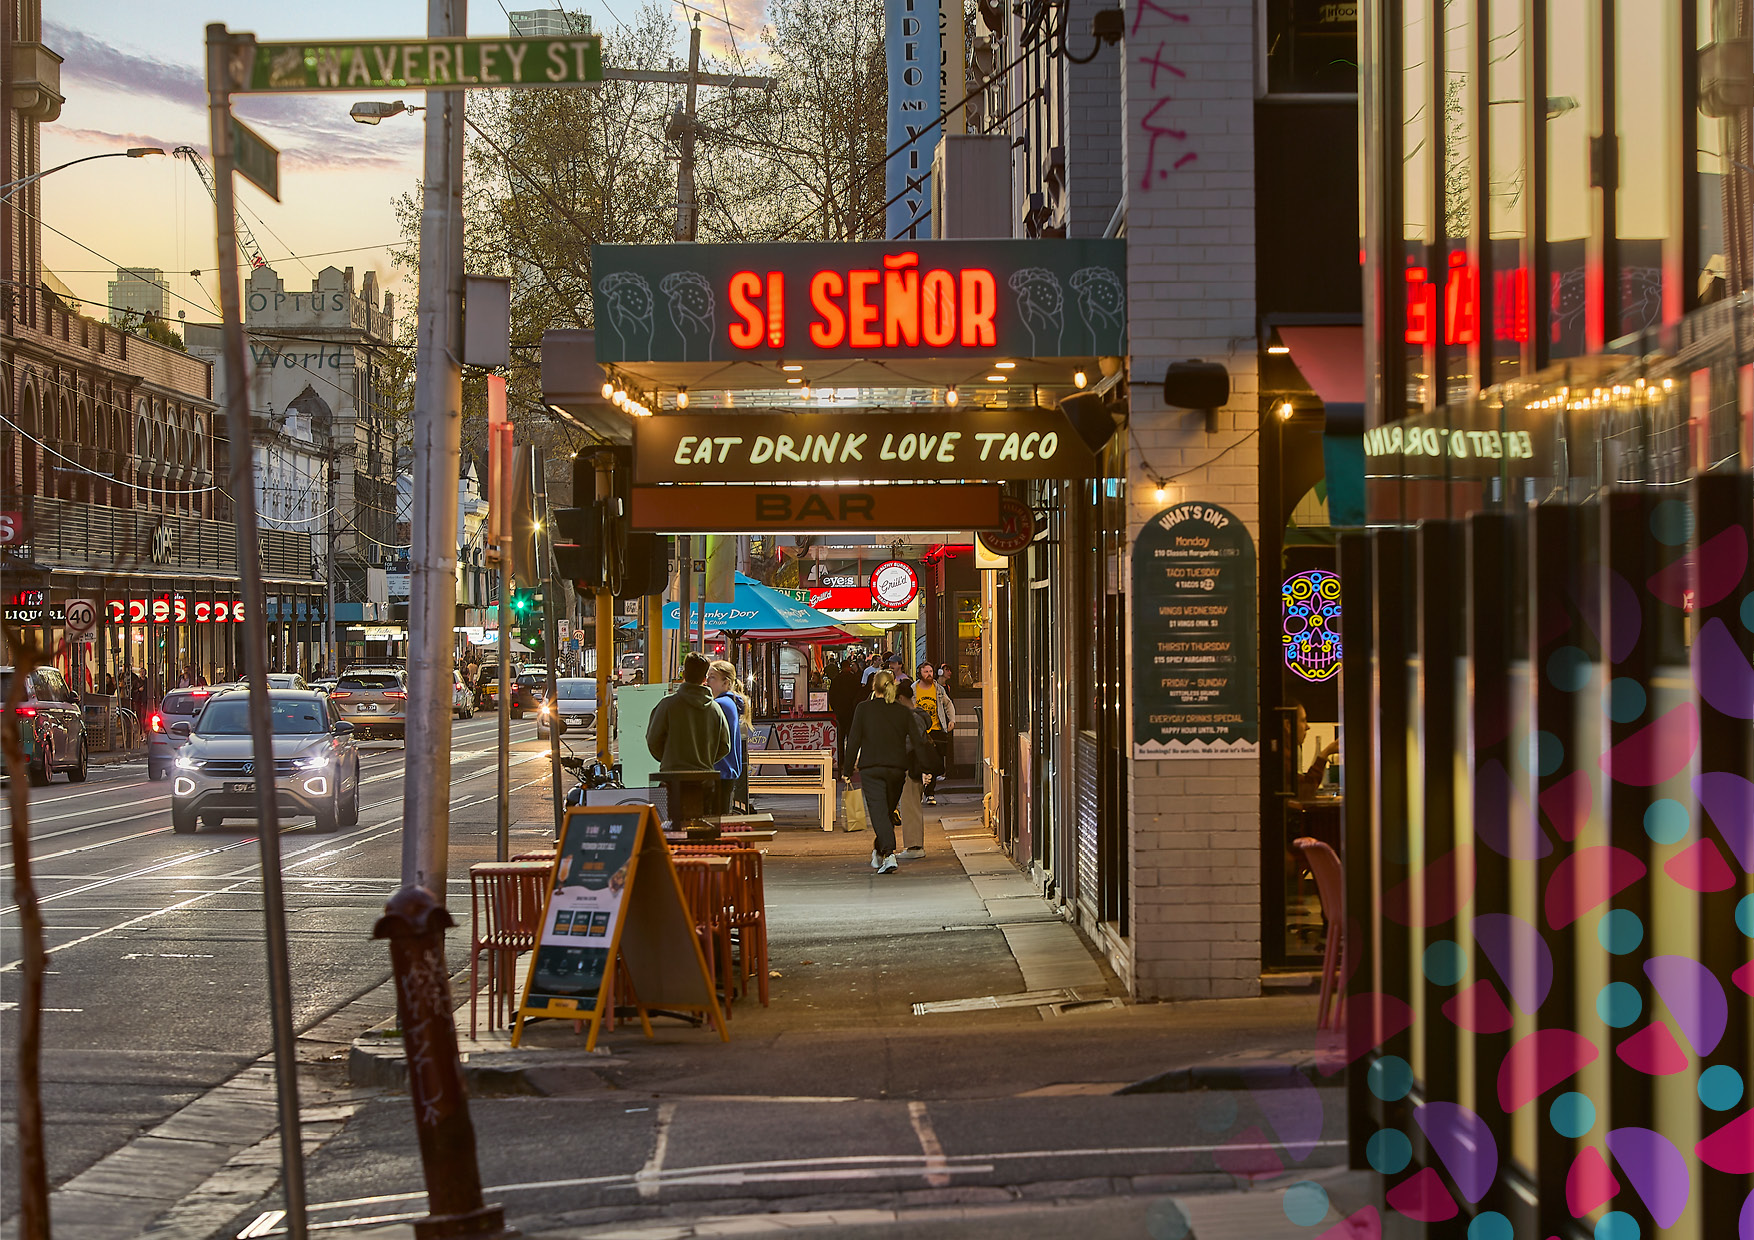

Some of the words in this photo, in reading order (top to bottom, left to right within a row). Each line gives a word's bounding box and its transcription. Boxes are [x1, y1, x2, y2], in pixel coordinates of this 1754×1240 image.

[315, 43, 527, 87] WAVERLEY
[546, 40, 591, 82] ST
[900, 100, 928, 112] AND
[248, 293, 344, 312] OPTUS
[728, 269, 786, 350] SI
[808, 250, 998, 349] SEÑOR
[249, 344, 342, 369] World
[673, 434, 743, 466] EAT
[748, 431, 869, 465] DRINK
[880, 430, 963, 463] LOVE
[974, 430, 1060, 463] TACO
[754, 492, 876, 522] BAR
[1158, 505, 1203, 531] WHAT'S
[1203, 508, 1230, 530] ON?
[1175, 536, 1210, 548] Monday
[1166, 549, 1188, 557] Classic
[875, 562, 894, 576] HEALTHY
[1166, 568, 1185, 577] TACO
[1186, 568, 1221, 577] TUESDAY
[795, 591, 807, 602] ST
[876, 594, 889, 606] MADE
[728, 608, 760, 620] Dory
[1159, 606, 1183, 615] WINGS
[1184, 605, 1228, 615] WEDNESDAY
[70, 609, 92, 624] 40
[1158, 642, 1190, 652] THIRSTY
[1191, 642, 1231, 652] THURSDAY
[1161, 678, 1189, 688] FRIDAY
[1197, 678, 1228, 688] SUNDAY
[1149, 715, 1186, 723] EVERYDAY
[1186, 714, 1213, 723] DRINKS
[1213, 714, 1243, 723] SPECIAL
